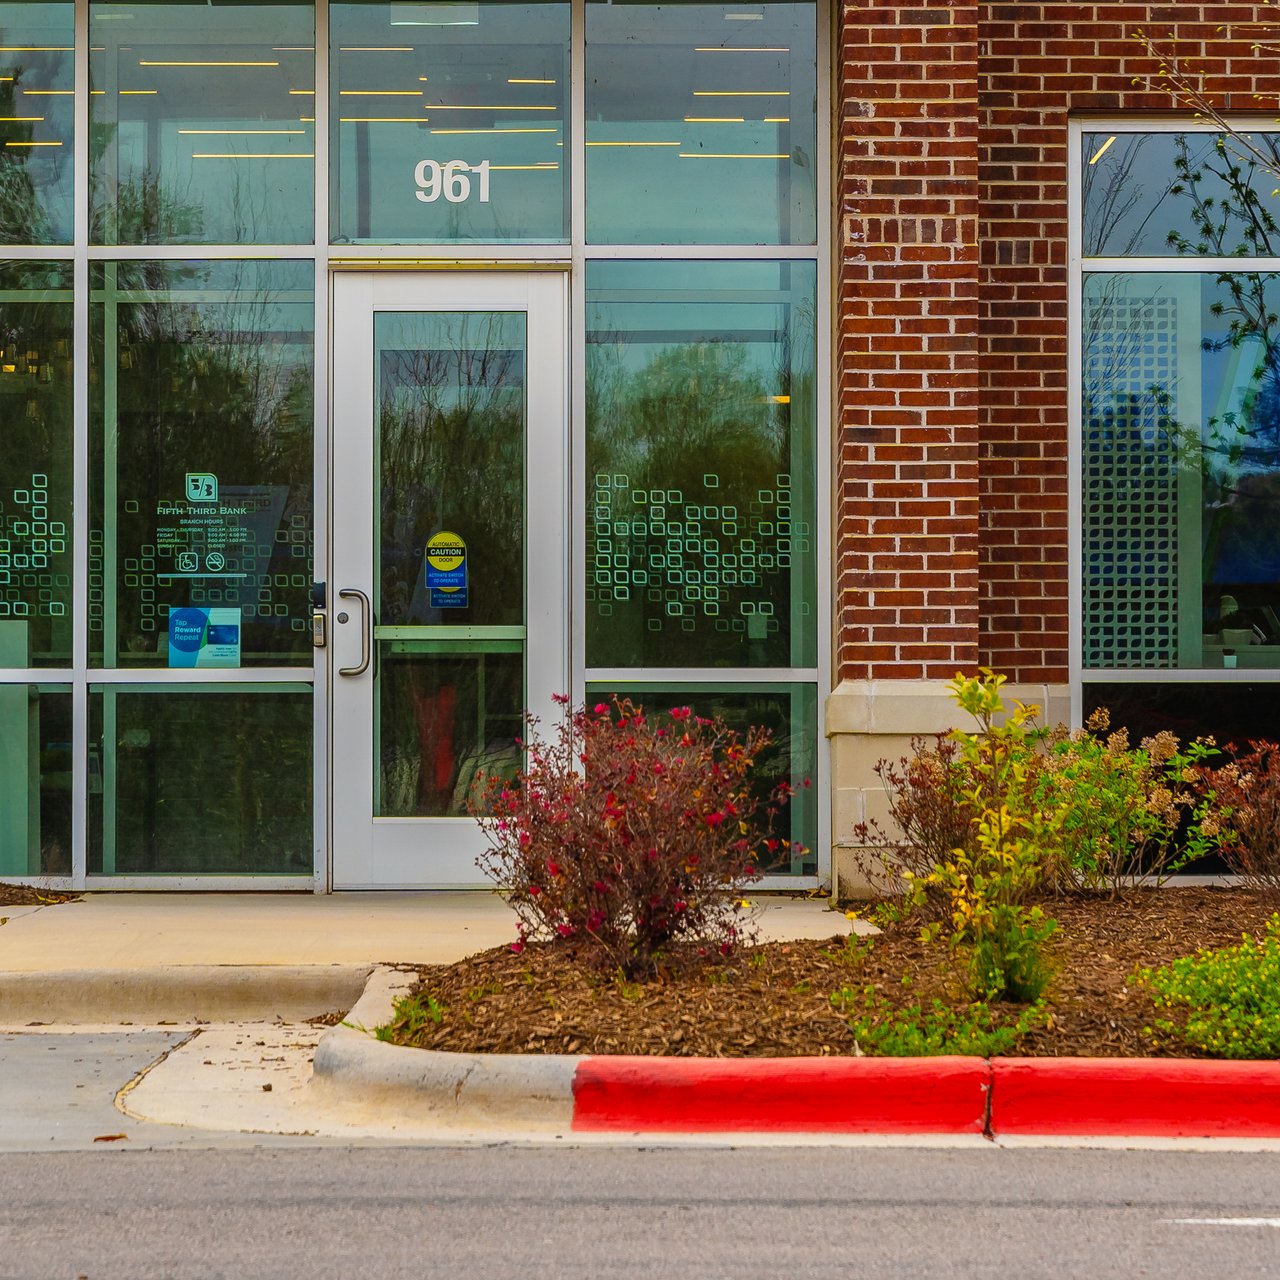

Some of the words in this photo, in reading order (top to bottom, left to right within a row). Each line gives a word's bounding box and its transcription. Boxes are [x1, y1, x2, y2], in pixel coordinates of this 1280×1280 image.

[414, 159, 490, 203] 961
[157, 507, 183, 515] FIFTH
[187, 507, 217, 515] THIRD
[220, 507, 247, 515] BANK
